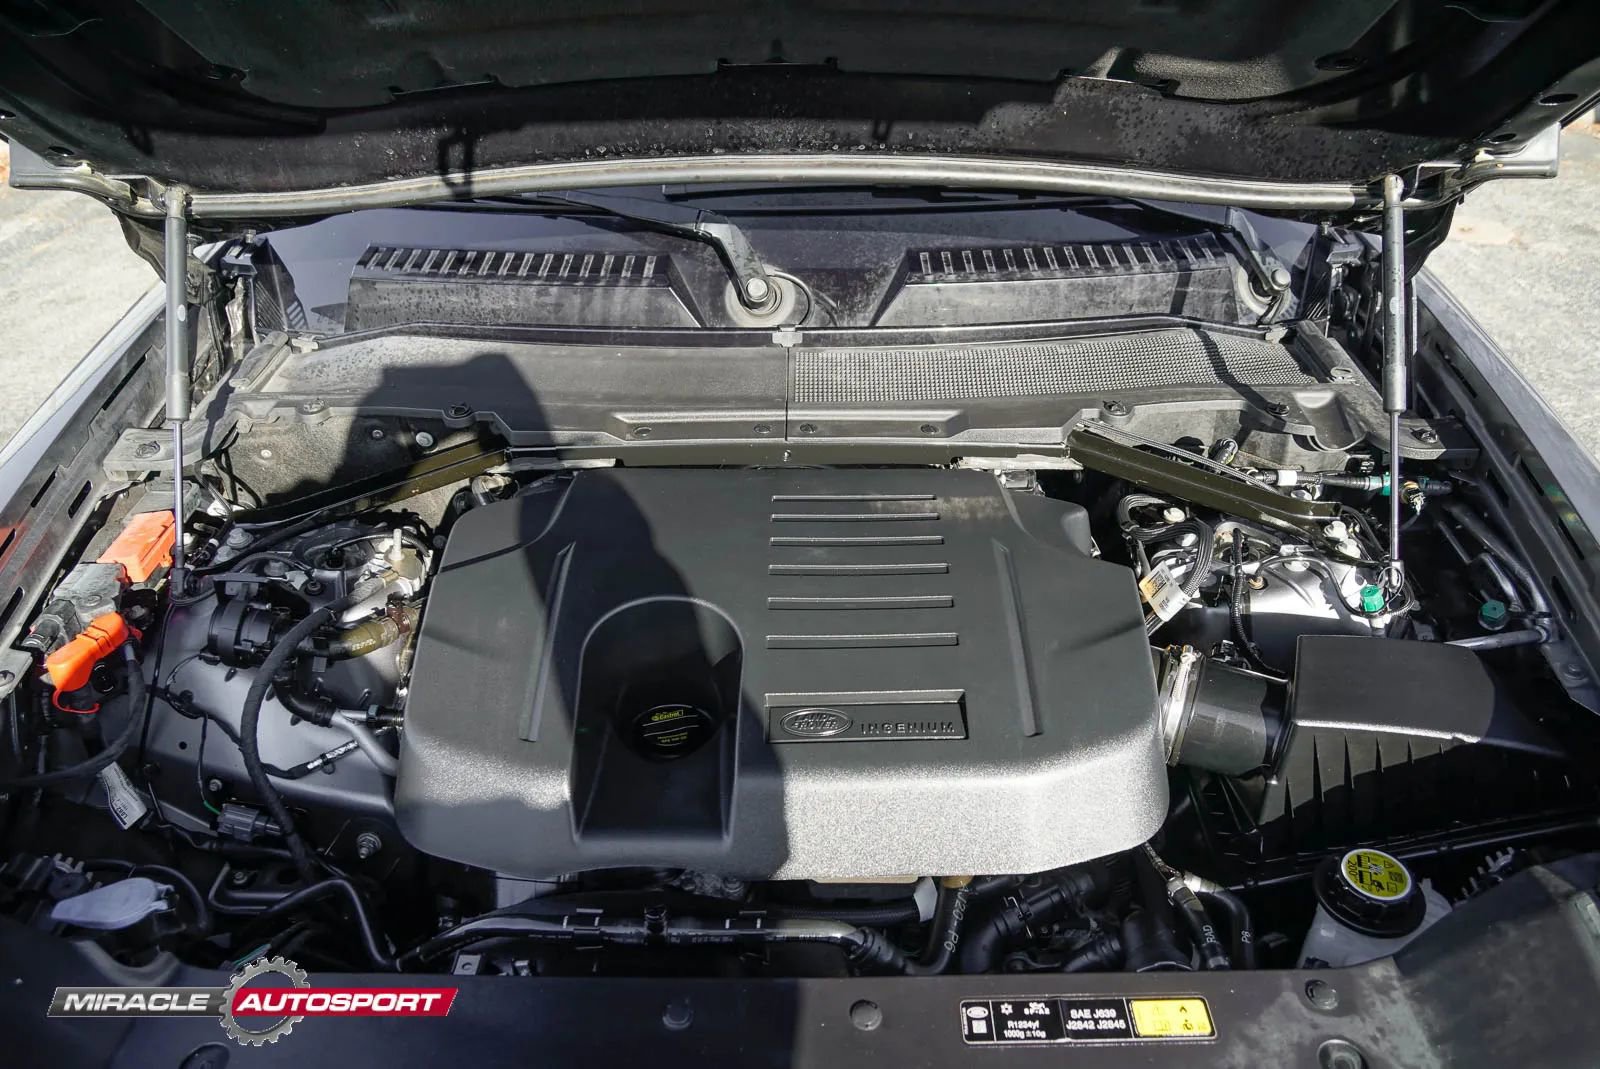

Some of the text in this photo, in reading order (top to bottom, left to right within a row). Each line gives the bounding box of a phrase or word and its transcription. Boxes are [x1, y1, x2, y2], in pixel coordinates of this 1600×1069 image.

[795, 712, 832, 722] LAND
[792, 720, 839, 731] ROVER
[860, 720, 956, 736] INGENIUM
[1202, 924, 1217, 943] RAD
[1070, 1008, 1117, 1019] SAE J639
[1066, 1019, 1126, 1030] J2842 J2845
[1003, 1030, 1025, 1040] 1000g
